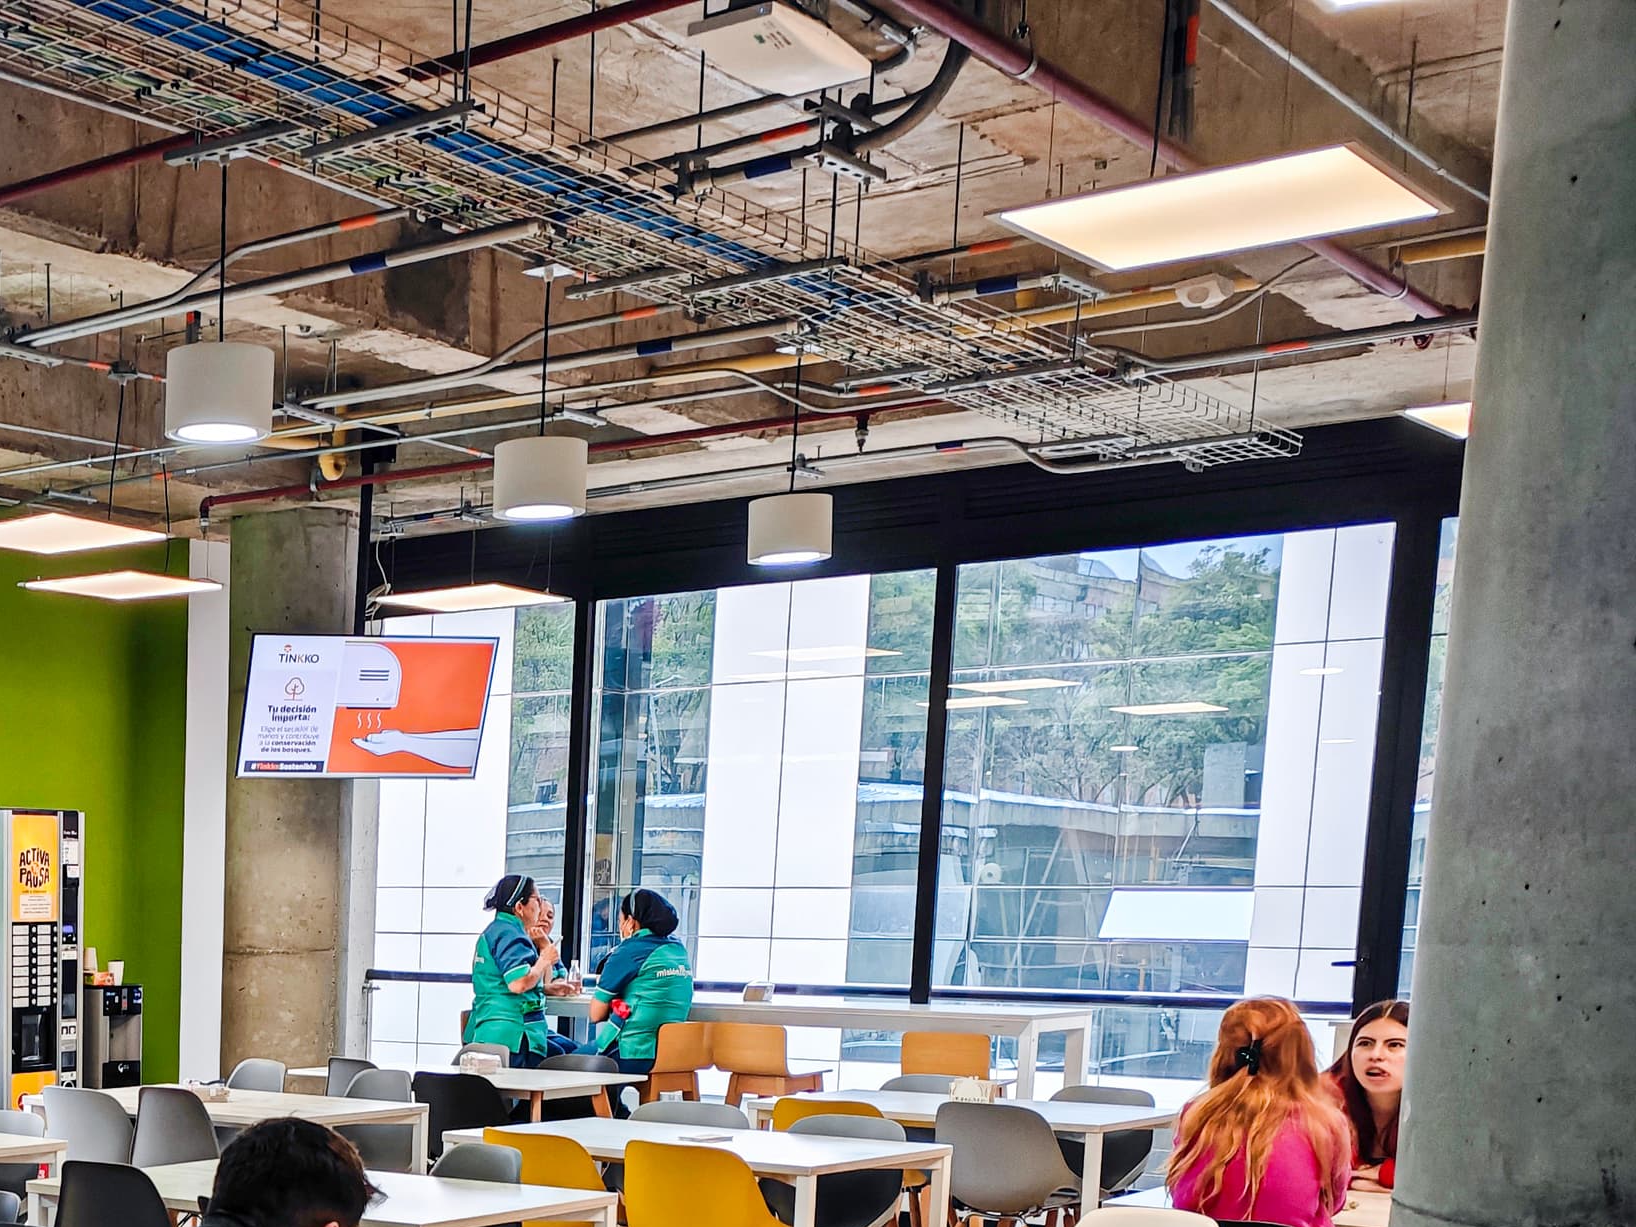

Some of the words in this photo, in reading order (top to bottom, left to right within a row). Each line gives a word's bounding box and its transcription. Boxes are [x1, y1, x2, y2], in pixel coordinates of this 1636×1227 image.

[278, 653, 320, 664] TINKKO
[268, 705, 278, 713] Tu
[280, 705, 317, 713] decisión
[19, 867, 50, 888] PAUSA
